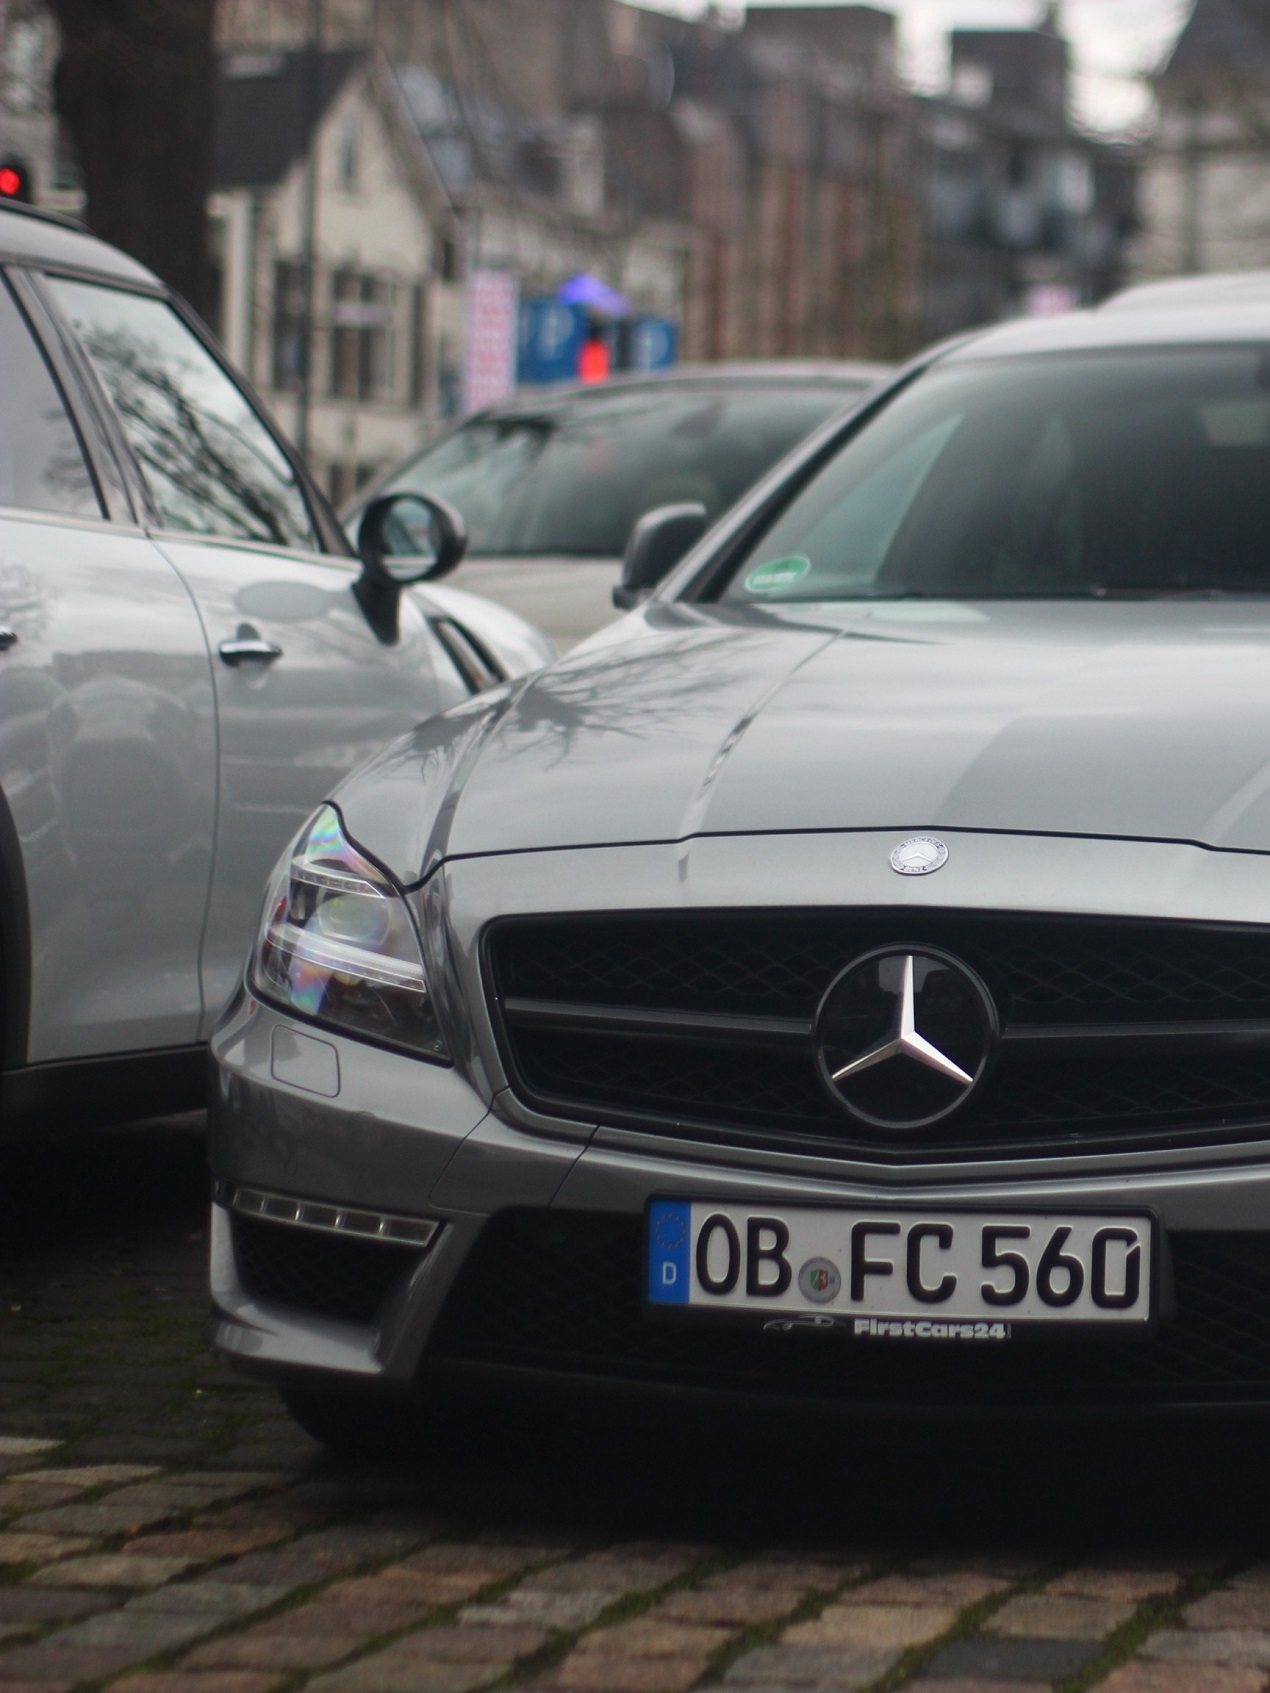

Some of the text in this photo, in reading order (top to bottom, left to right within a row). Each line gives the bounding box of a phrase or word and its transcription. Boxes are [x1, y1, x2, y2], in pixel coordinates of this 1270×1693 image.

[662, 1261, 677, 1286] D
[696, 1213, 792, 1297] OB
[850, 1222, 957, 1304] FC
[981, 1226, 1140, 1309] 560
[853, 1318, 1006, 1340] FirstCars24
